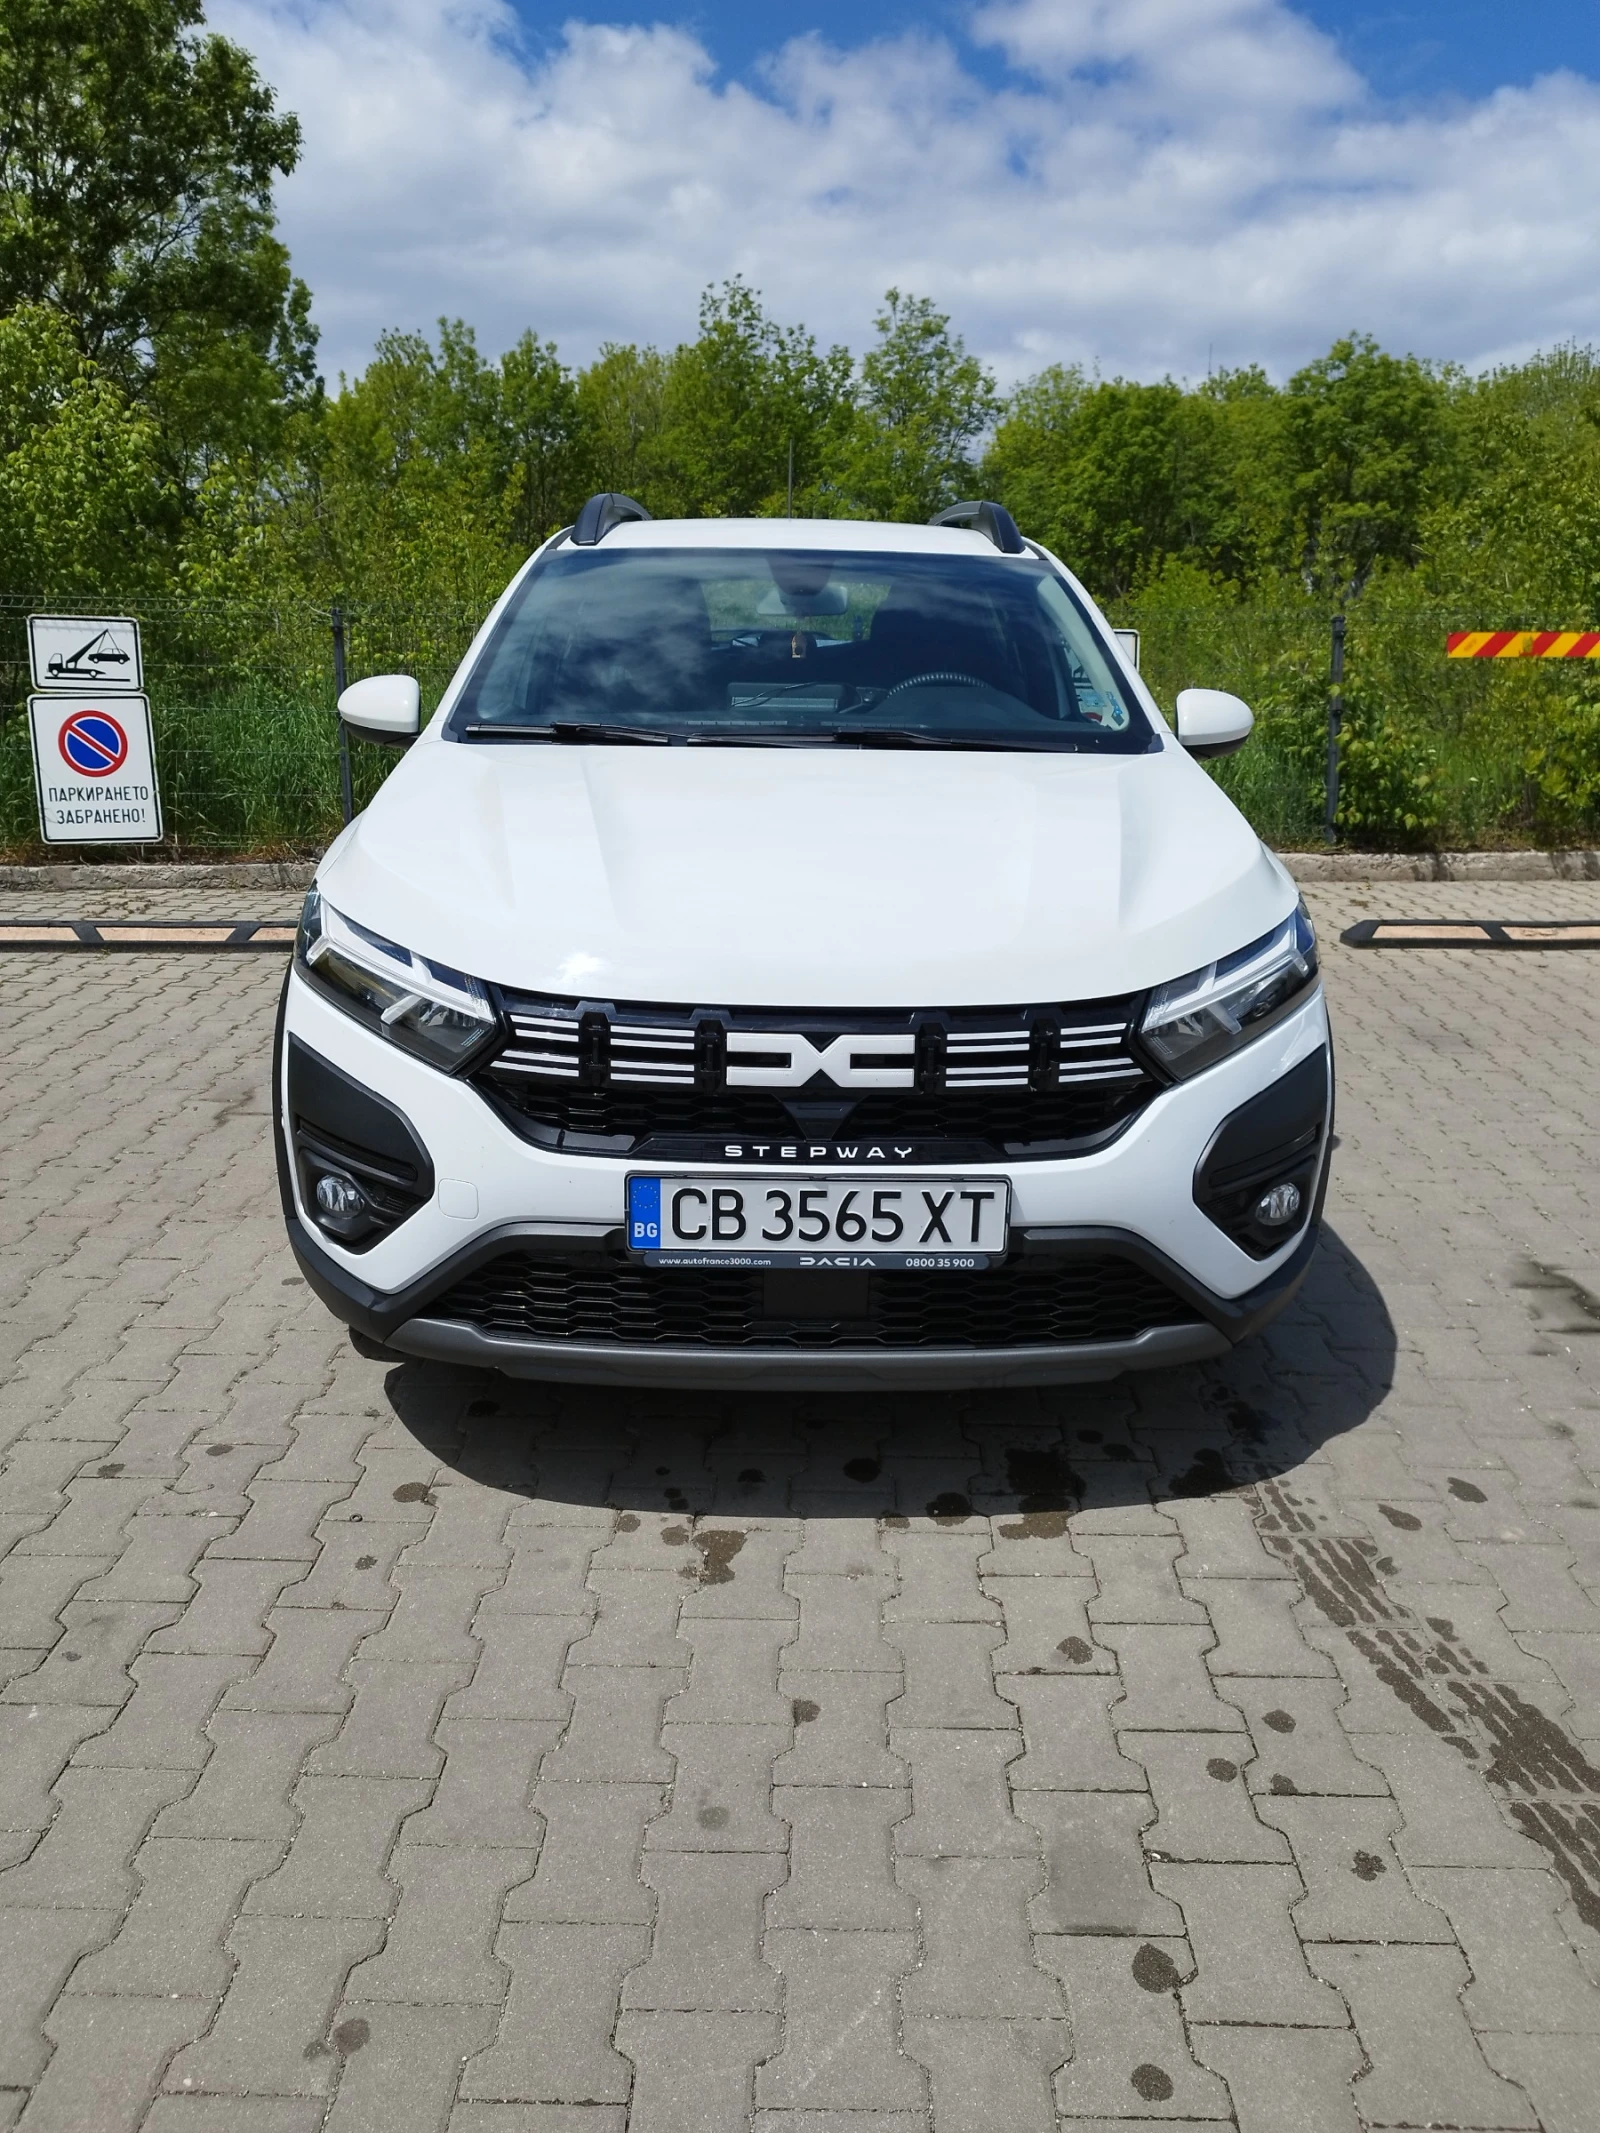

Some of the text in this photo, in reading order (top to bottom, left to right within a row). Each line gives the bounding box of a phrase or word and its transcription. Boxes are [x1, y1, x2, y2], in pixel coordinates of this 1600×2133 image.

[48, 786, 149, 802] ПАРКИРАНЕТО
[56, 808, 146, 825] ЗАБРАНЕНО!
[724, 1145, 913, 1159] STEPWAY
[671, 1188, 995, 1243] CB 3565 XT
[633, 1222, 658, 1239] BG
[658, 1257, 772, 1266] www.autofrance3000.com
[799, 1257, 877, 1266] DACIA
[905, 1258, 975, 1268] 0800 35 900
